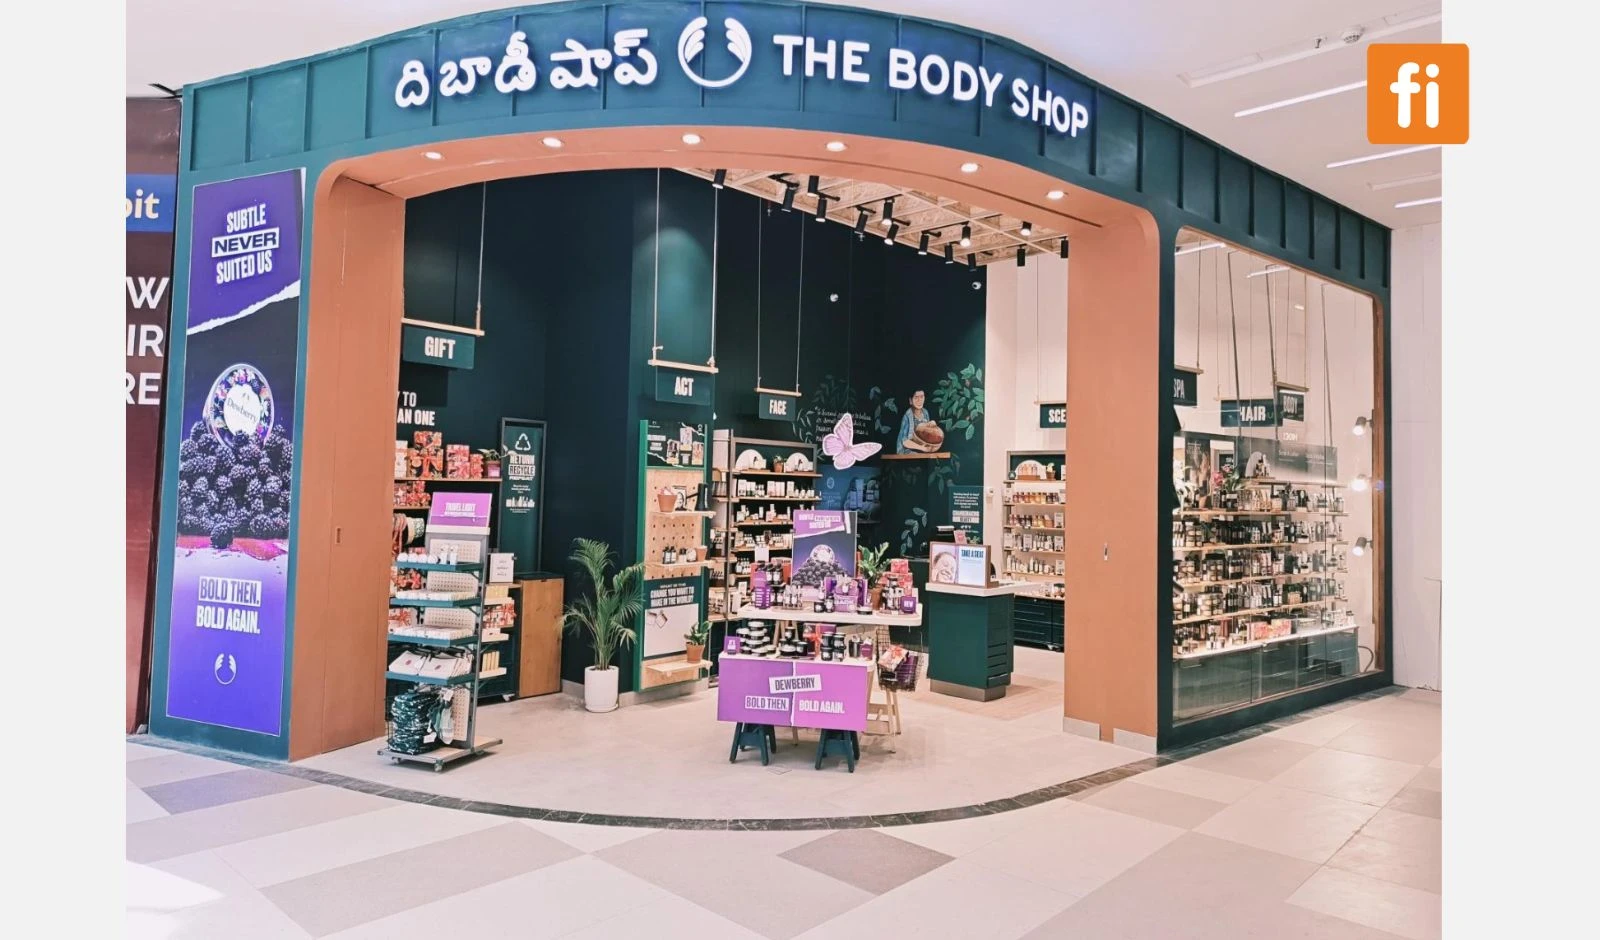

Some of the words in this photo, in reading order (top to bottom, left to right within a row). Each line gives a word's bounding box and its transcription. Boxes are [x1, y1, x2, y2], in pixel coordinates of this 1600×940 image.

[395, 60, 430, 108] ది
[439, 31, 537, 97] బాడీ
[550, 28, 658, 89] షాప్
[773, 34, 870, 83] THE
[888, 48, 1003, 107] BODY
[1011, 78, 1089, 138] SHOP
[226, 203, 267, 233] SUBTLE
[214, 231, 277, 254] NEVER
[216, 256, 256, 284] SUITED
[256, 250, 273, 275] US
[424, 336, 456, 359] GIFT
[674, 376, 694, 397] ACT
[402, 391, 417, 408] TO
[769, 399, 787, 415] FACE
[1283, 395, 1298, 415] BODY
[414, 409, 436, 426] ONE
[1048, 408, 1067, 424] SCE
[1239, 406, 1266, 422] HAIR
[509, 465, 534, 475] RECYCLE
[200, 578, 228, 601] BOLD
[230, 580, 260, 605] THEN.
[196, 605, 225, 629] BOLD
[225, 608, 260, 634] AGAIN.
[775, 677, 815, 691] DEWBERRY
[746, 696, 765, 708] BOLD
[767, 698, 788, 710] THEN.
[799, 699, 819, 712] BOLD
[819, 701, 845, 714] AGAIN.
